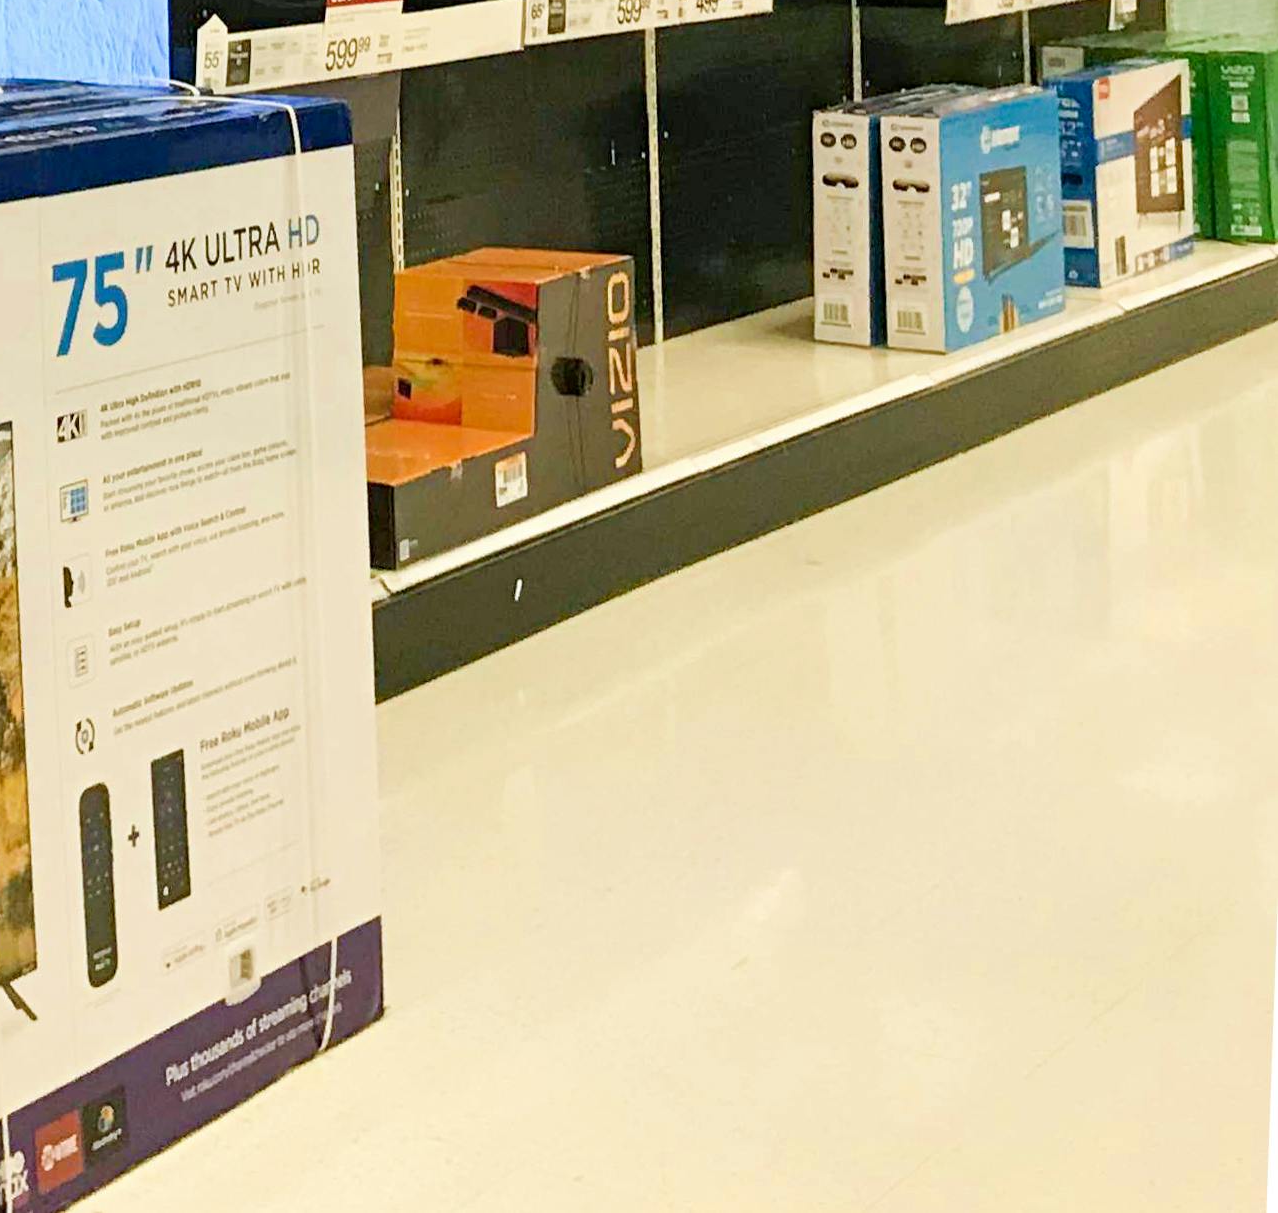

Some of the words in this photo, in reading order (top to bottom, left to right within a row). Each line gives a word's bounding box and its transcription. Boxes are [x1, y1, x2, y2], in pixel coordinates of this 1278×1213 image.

[52, 245, 153, 357] 75"
[165, 237, 197, 274] 4K
[205, 221, 280, 267] ULTRA
[288, 214, 320, 249] HD
[167, 280, 218, 307] SMART
[225, 274, 242, 294] TV
[248, 263, 285, 289] WITH
[607, 270, 636, 469] VIZIO
[199, 737, 219, 754] Free
[243, 716, 271, 739] Mobile
[273, 706, 290, 727] App
